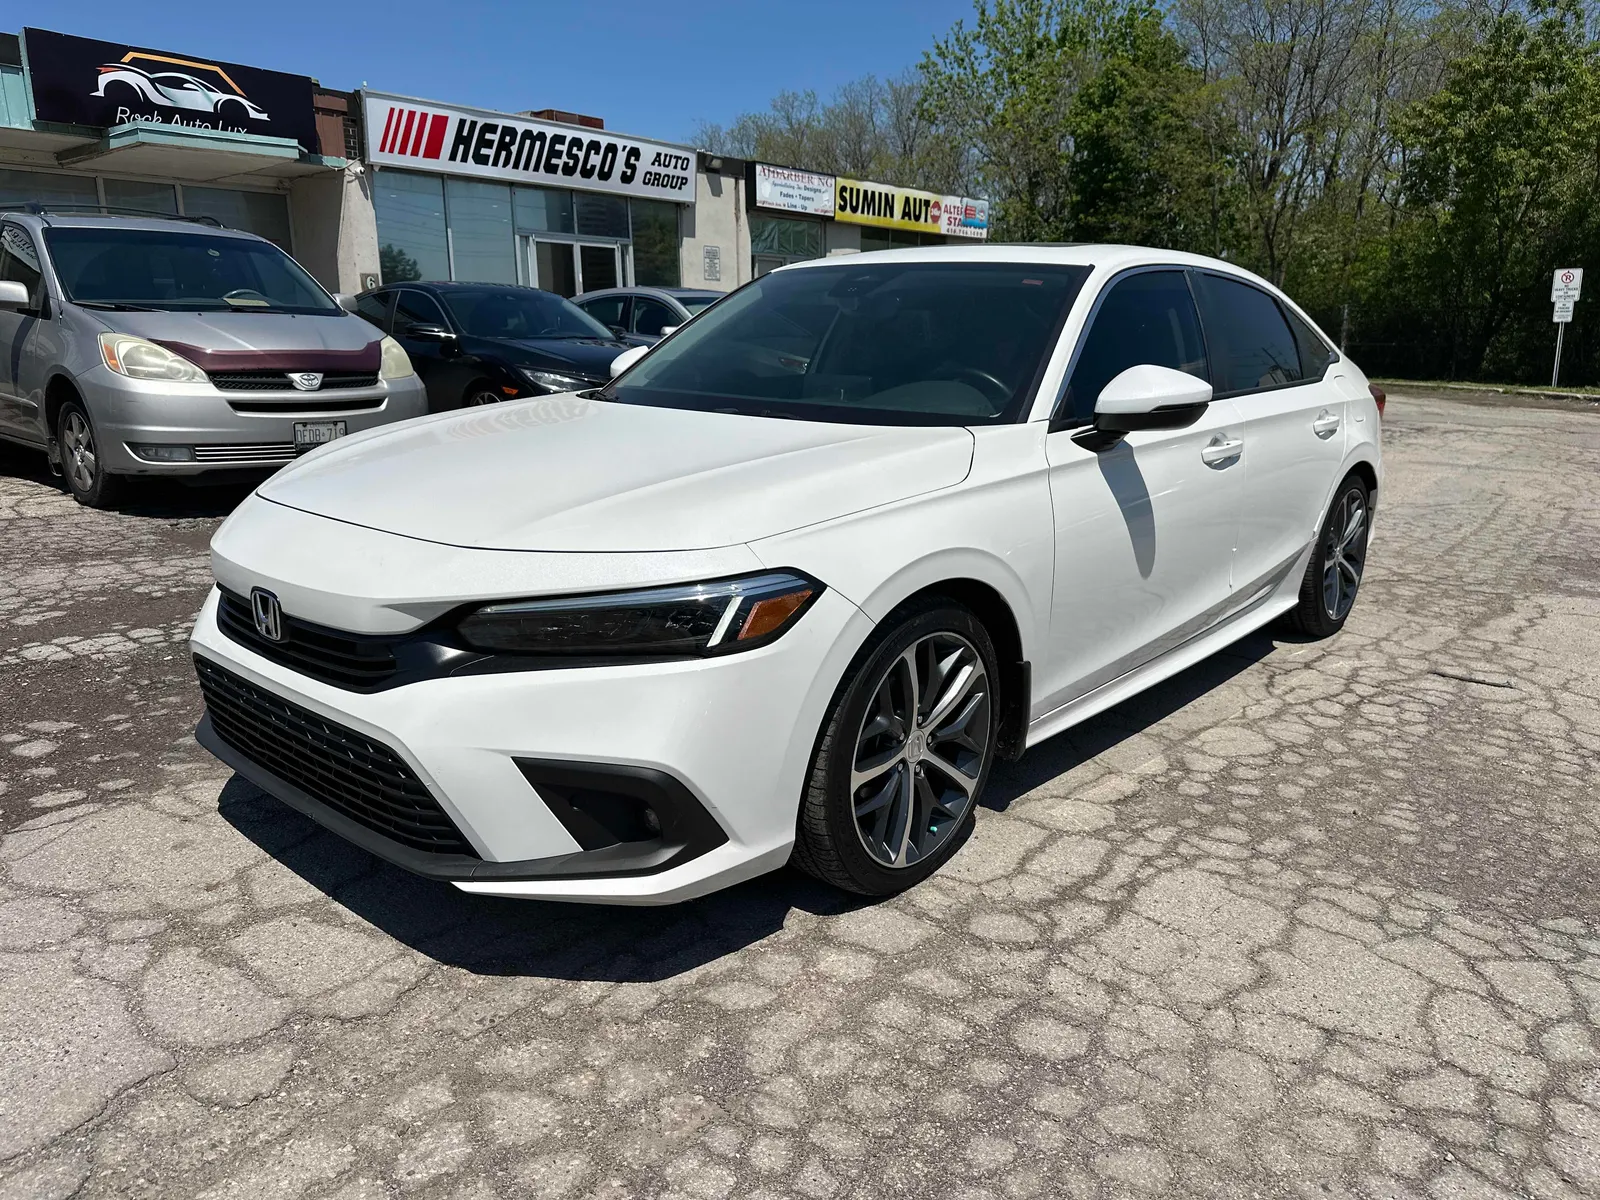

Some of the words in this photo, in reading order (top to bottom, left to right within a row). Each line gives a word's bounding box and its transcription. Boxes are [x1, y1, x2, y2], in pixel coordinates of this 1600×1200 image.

[448, 118, 642, 185] HERMESCO'S
[651, 151, 690, 171] AUTO
[642, 170, 689, 191] GROUP
[804, 185, 822, 194] Designs
[780, 191, 794, 200] Fades
[799, 194, 815, 202] Tapers
[838, 185, 895, 219] SUMIN
[366, 276, 376, 290] 6
